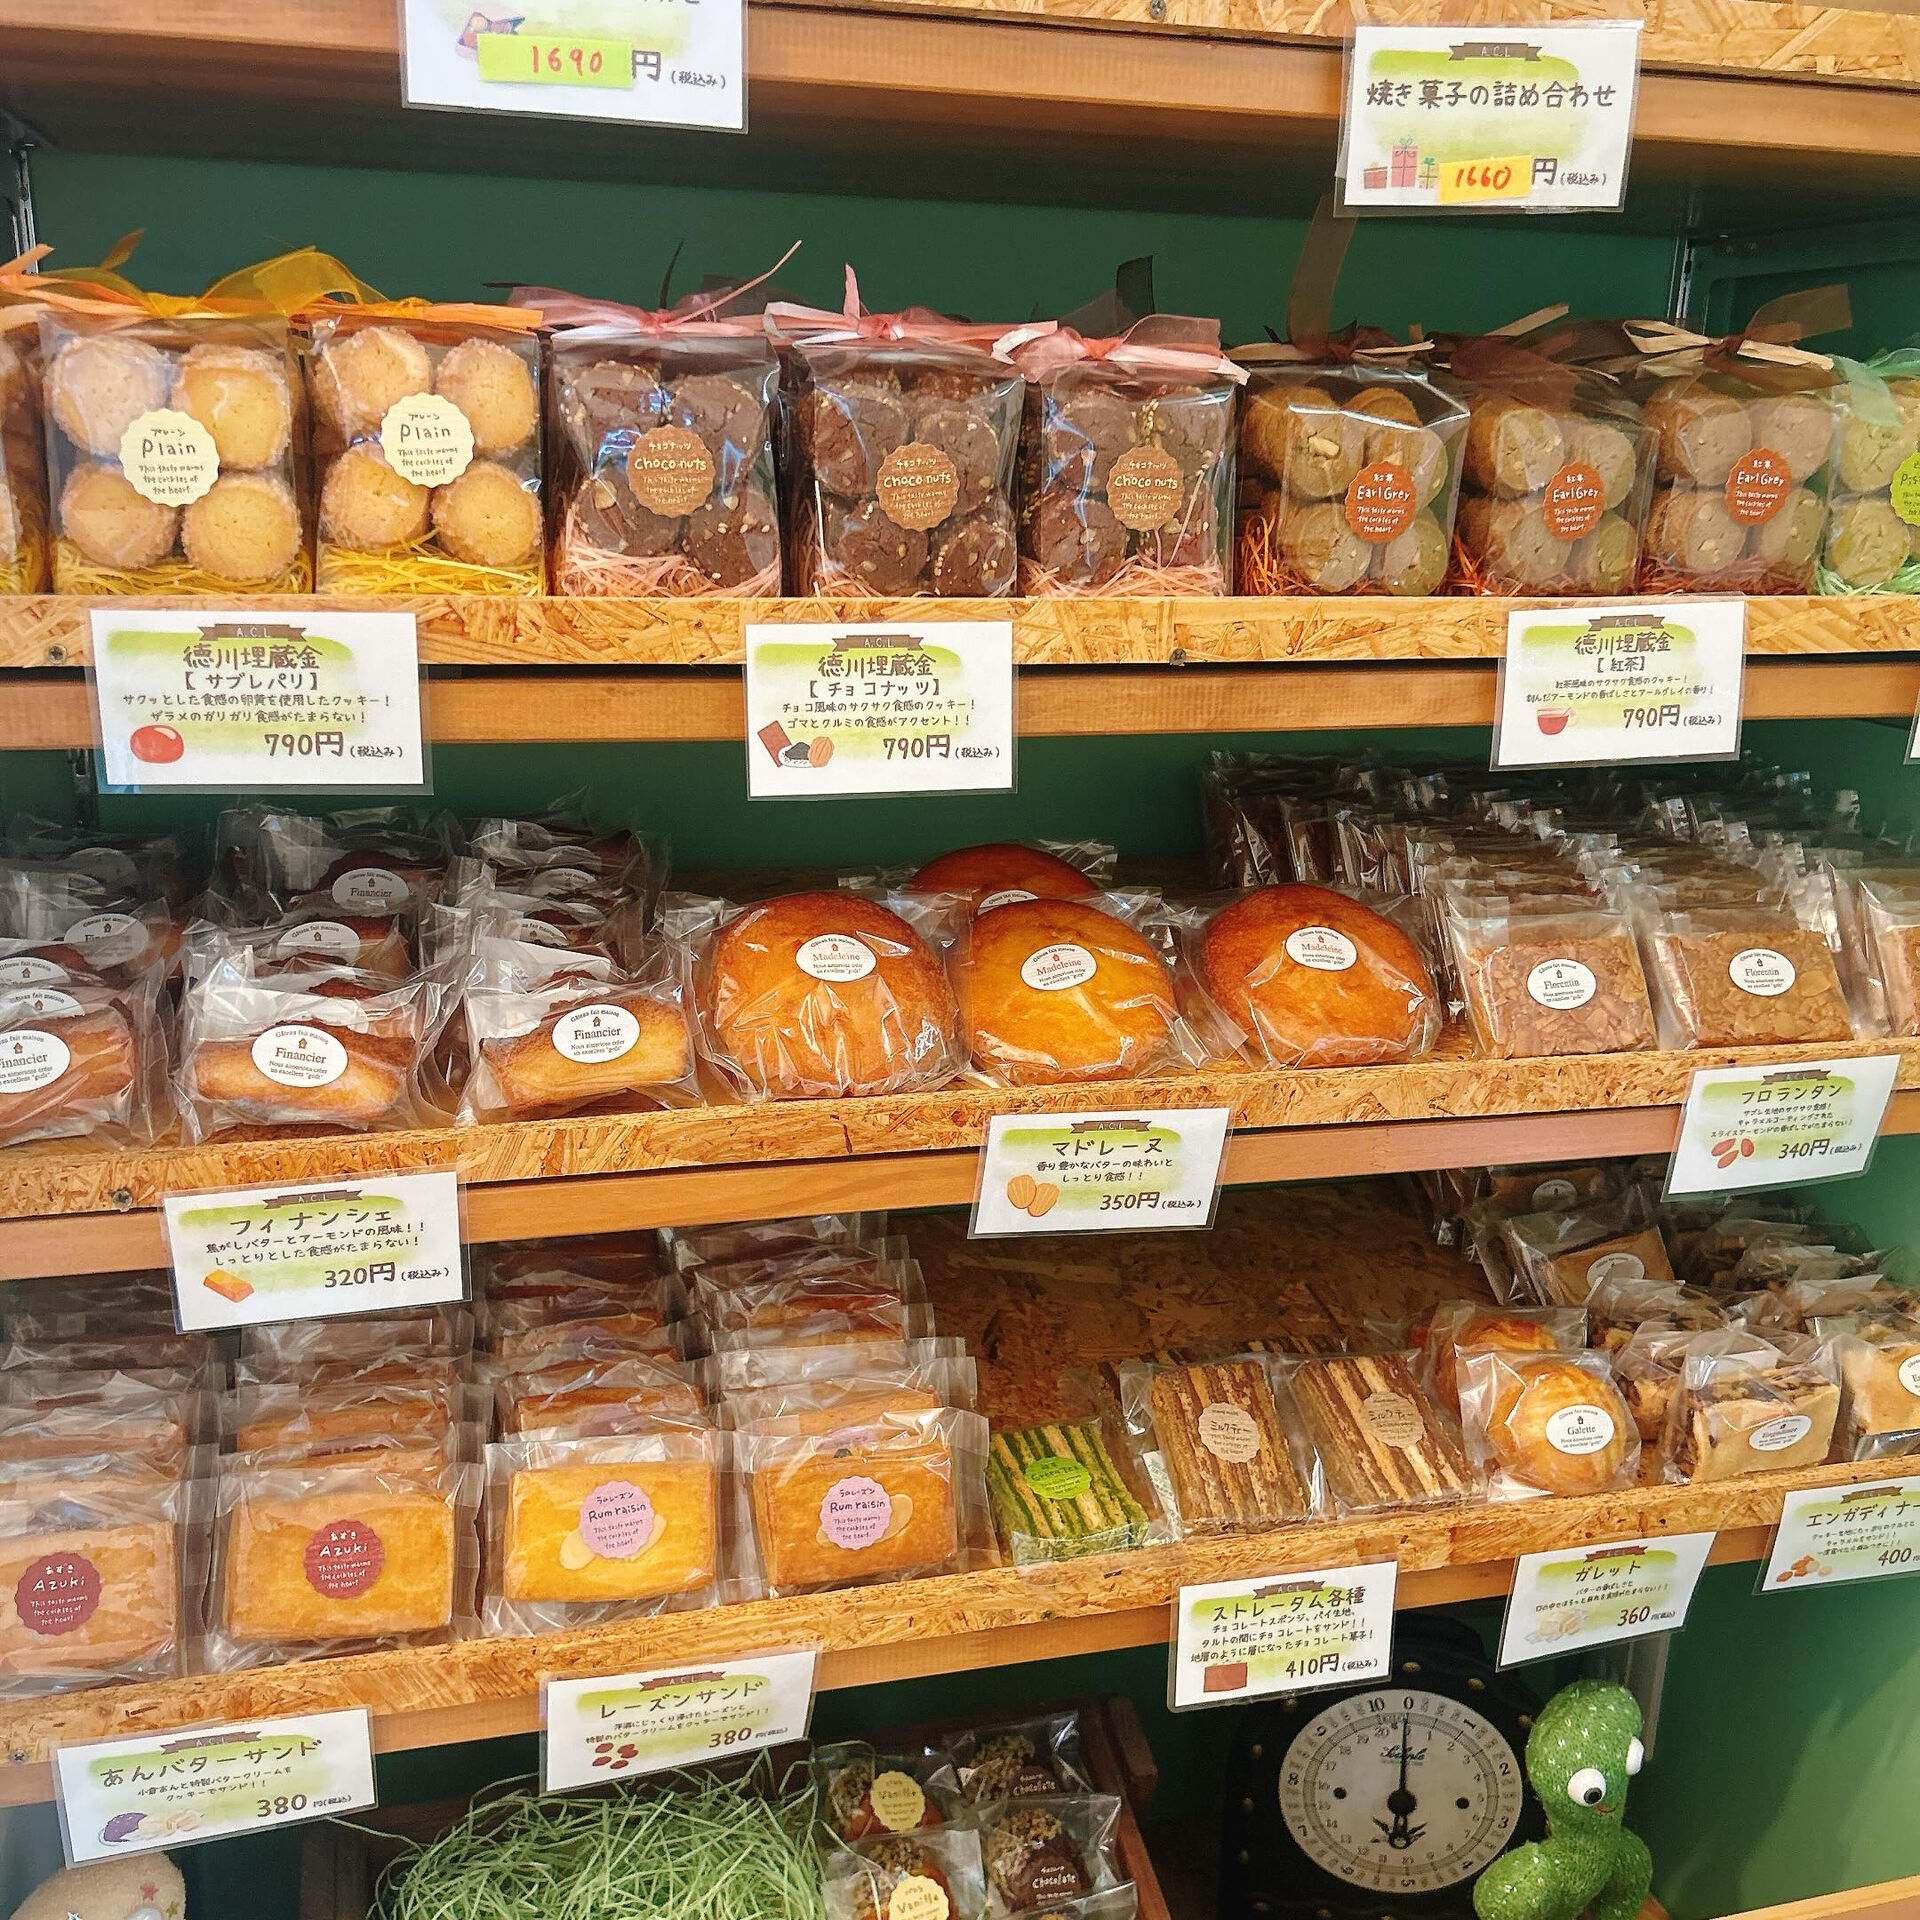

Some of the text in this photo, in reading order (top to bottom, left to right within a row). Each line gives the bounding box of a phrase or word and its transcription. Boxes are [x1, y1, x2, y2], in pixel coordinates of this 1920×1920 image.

[531, 45, 603, 76] 1690
[671, 69, 727, 89] (税込み)
[1366, 79, 1616, 108] 焼き菓子の詰め合わせ
[1455, 166, 1511, 190] 1660
[1560, 172, 1606, 186] (税込み)
[400, 423, 451, 443] Plain
[142, 438, 197, 458] Plain
[1575, 632, 1674, 656] 徳川埋蔵金
[183, 643, 322, 670] 徳川埋蔵金
[818, 653, 936, 678] 徳川埋蔵金
[1623, 704, 1721, 729] 790円 (税込み)
[264, 731, 403, 758] 790円 (税込み)
[883, 734, 1000, 760] 790円 (税込み)
[812, 953, 861, 961] Madeleine
[1036, 960, 1082, 976] Madeleine
[573, 1027, 621, 1040] Financier
[275, 1047, 327, 1064] Financier
[1741, 1084, 1843, 1104] フロランタン
[1052, 1138, 1163, 1157] マドレーヌ
[1778, 1138, 1831, 1160] 340円
[1100, 1191, 1202, 1211] 350円 (税込み)
[230, 1208, 392, 1236] フィナンシェ
[324, 1261, 450, 1288] 320円 (税込み)
[1567, 1426, 1596, 1435] Galette
[588, 1504, 646, 1522] Rum raisin
[830, 1501, 885, 1513] Rum raisin
[320, 1543, 367, 1557] Azuki
[1878, 1548, 1912, 1566] 400
[1575, 1560, 1641, 1582] ガレット
[33, 1576, 84, 1591] Azuki
[1213, 1586, 1367, 1622] ストレータム各種
[1617, 1606, 1650, 1626] 360
[1285, 1653, 1339, 1679] 410円
[600, 1681, 764, 1719] レーズンサンド
[1367, 1697, 1385, 1712] 10
[708, 1727, 752, 1749] 380
[100, 1739, 323, 1787] あんバターサンド
[257, 1794, 307, 1817] 380
